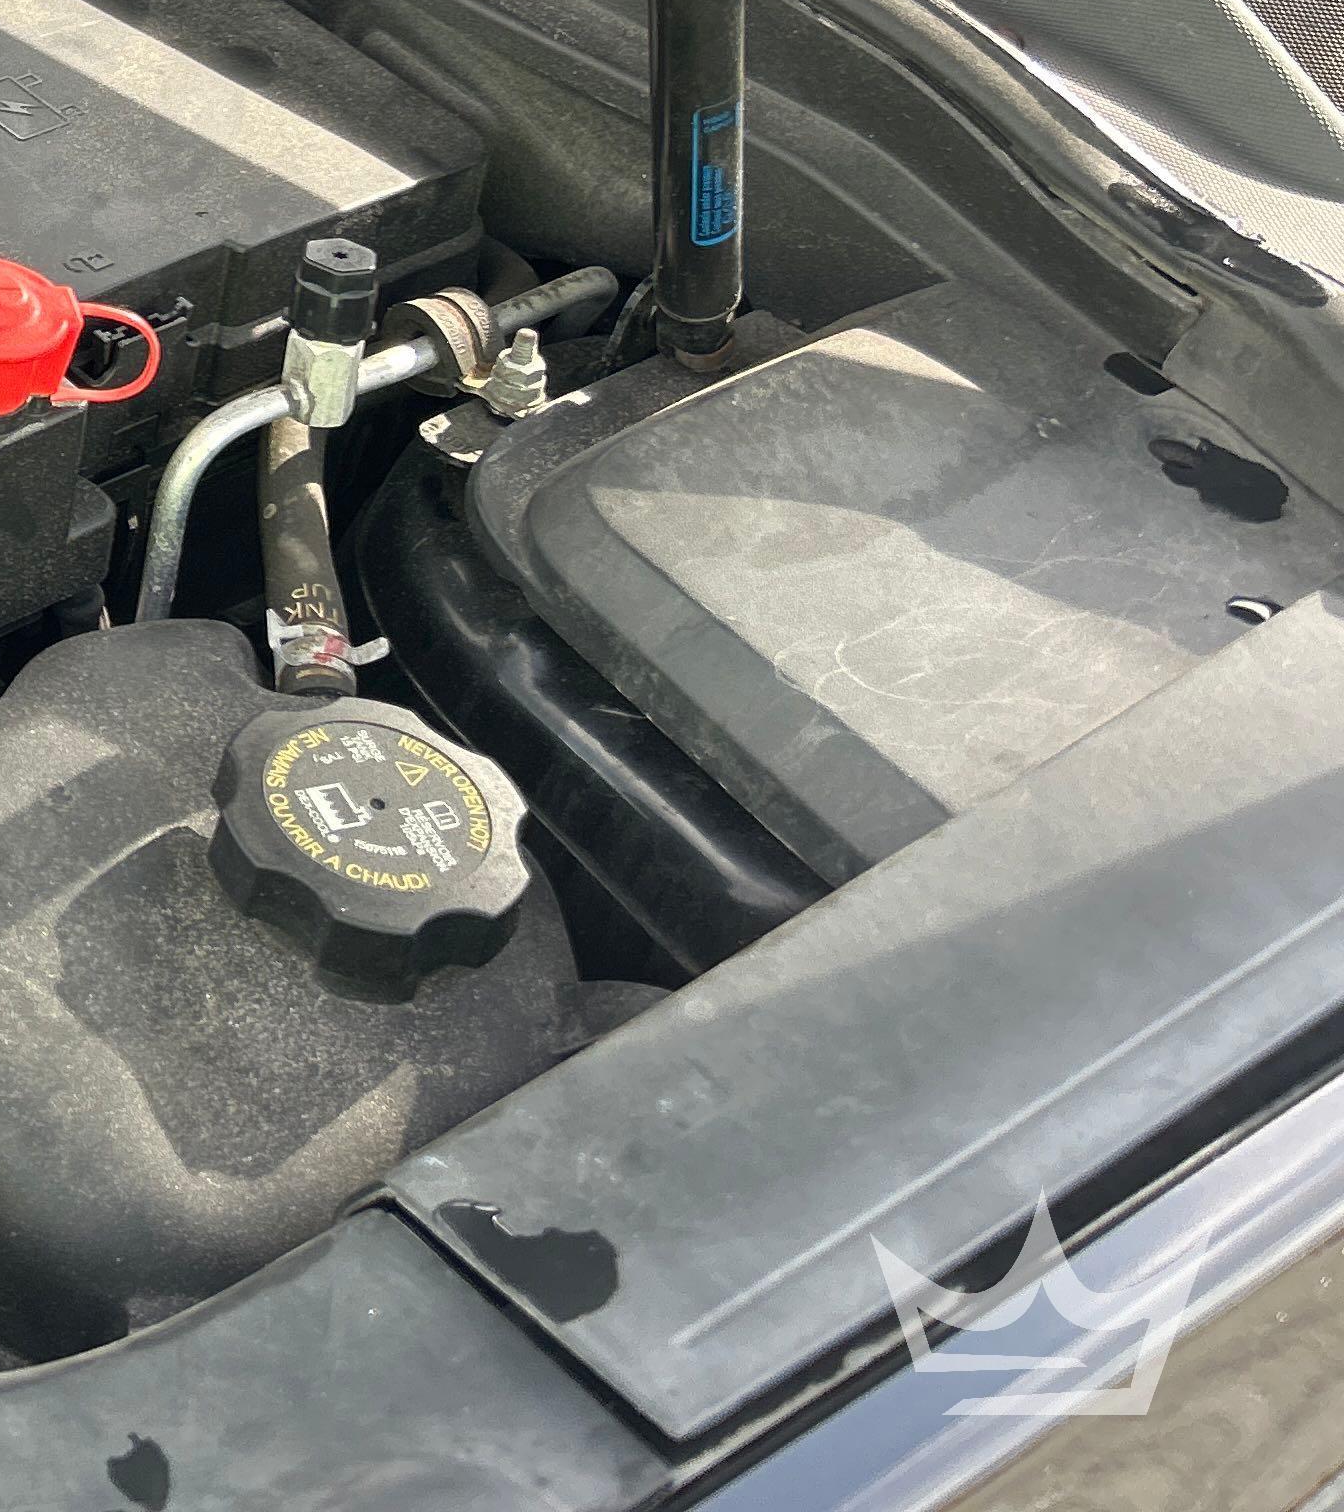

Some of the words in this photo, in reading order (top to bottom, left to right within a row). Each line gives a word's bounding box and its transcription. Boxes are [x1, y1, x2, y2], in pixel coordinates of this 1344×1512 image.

[291, 583, 334, 601] UP
[298, 728, 330, 750] NE
[357, 729, 387, 763] SURGE
[397, 734, 458, 778] NEVER
[265, 739, 304, 789] JAMAIS
[452, 775, 487, 817] OPEN
[269, 793, 326, 858] OUVRIR
[466, 817, 491, 852] HOT!
